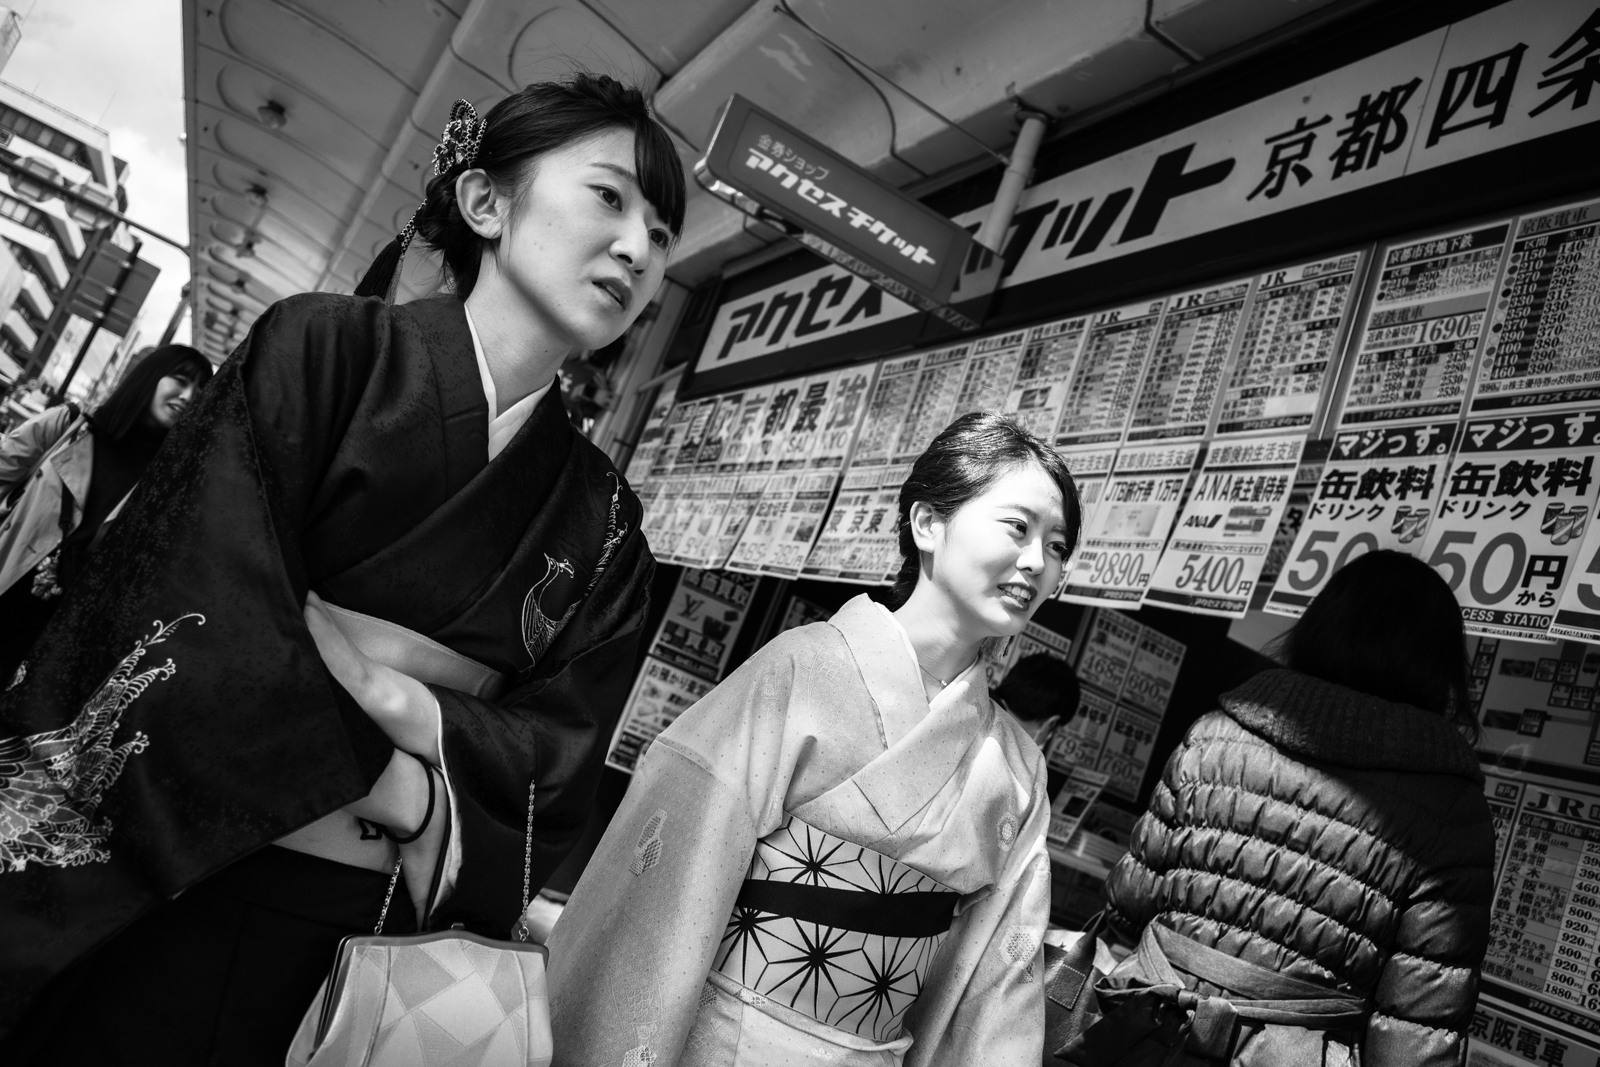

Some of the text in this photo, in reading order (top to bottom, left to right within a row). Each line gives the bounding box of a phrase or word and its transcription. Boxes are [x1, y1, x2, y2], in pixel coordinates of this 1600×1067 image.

[756, 133, 831, 181] 金券ショップ
[744, 147, 936, 265] アクセスチケット
[1521, 207, 1590, 234] 京阪電車
[1388, 234, 1474, 265] 京都市営地下鉄
[1522, 247, 1547, 262] 150
[1519, 259, 1544, 273] 210
[1261, 270, 1287, 289] JR
[1516, 271, 1541, 285] 270
[1513, 282, 1537, 296] 310
[1169, 293, 1203, 311] JR
[1509, 294, 1534, 308] 330
[1373, 305, 1424, 328] 近鉄電車
[1506, 306, 1531, 320] 350
[1503, 318, 1528, 332] 370
[1500, 330, 1525, 343] 390
[1497, 342, 1522, 355] 400
[1494, 354, 1518, 367] 410
[1491, 366, 1515, 379] 460
[1338, 425, 1447, 458] マジっす。
[1318, 463, 1438, 501] 缶飲料
[1448, 456, 1595, 497] 缶飲料
[1308, 502, 1385, 522] ドリンク
[1438, 499, 1532, 520] ドリンク
[1182, 514, 1211, 528] ANA
[1175, 554, 1254, 596] 5400円
[686, 568, 750, 606] 高価買取
[1514, 589, 1556, 608] から
[1460, 607, 1495, 622] CESS
[1550, 627, 1594, 640] AUTOMATIC
[685, 631, 723, 657] 買取
[1527, 791, 1585, 819] JR
[1518, 825, 1552, 843] 長岡京
[1514, 838, 1548, 856] 高槻
[1503, 875, 1539, 892] 大阪
[1500, 887, 1534, 905] 京橋
[1492, 911, 1594, 949] 天王寺 920円
[1565, 919, 1597, 936] 920円
[1489, 922, 1525, 942] 弁天町
[1557, 945, 1590, 963] 800円
[1554, 958, 1586, 976] 920円
[1550, 971, 1582, 989] 800円
[1543, 983, 1579, 1003] 1880円
[1468, 1010, 1569, 1067] 京阪電車
